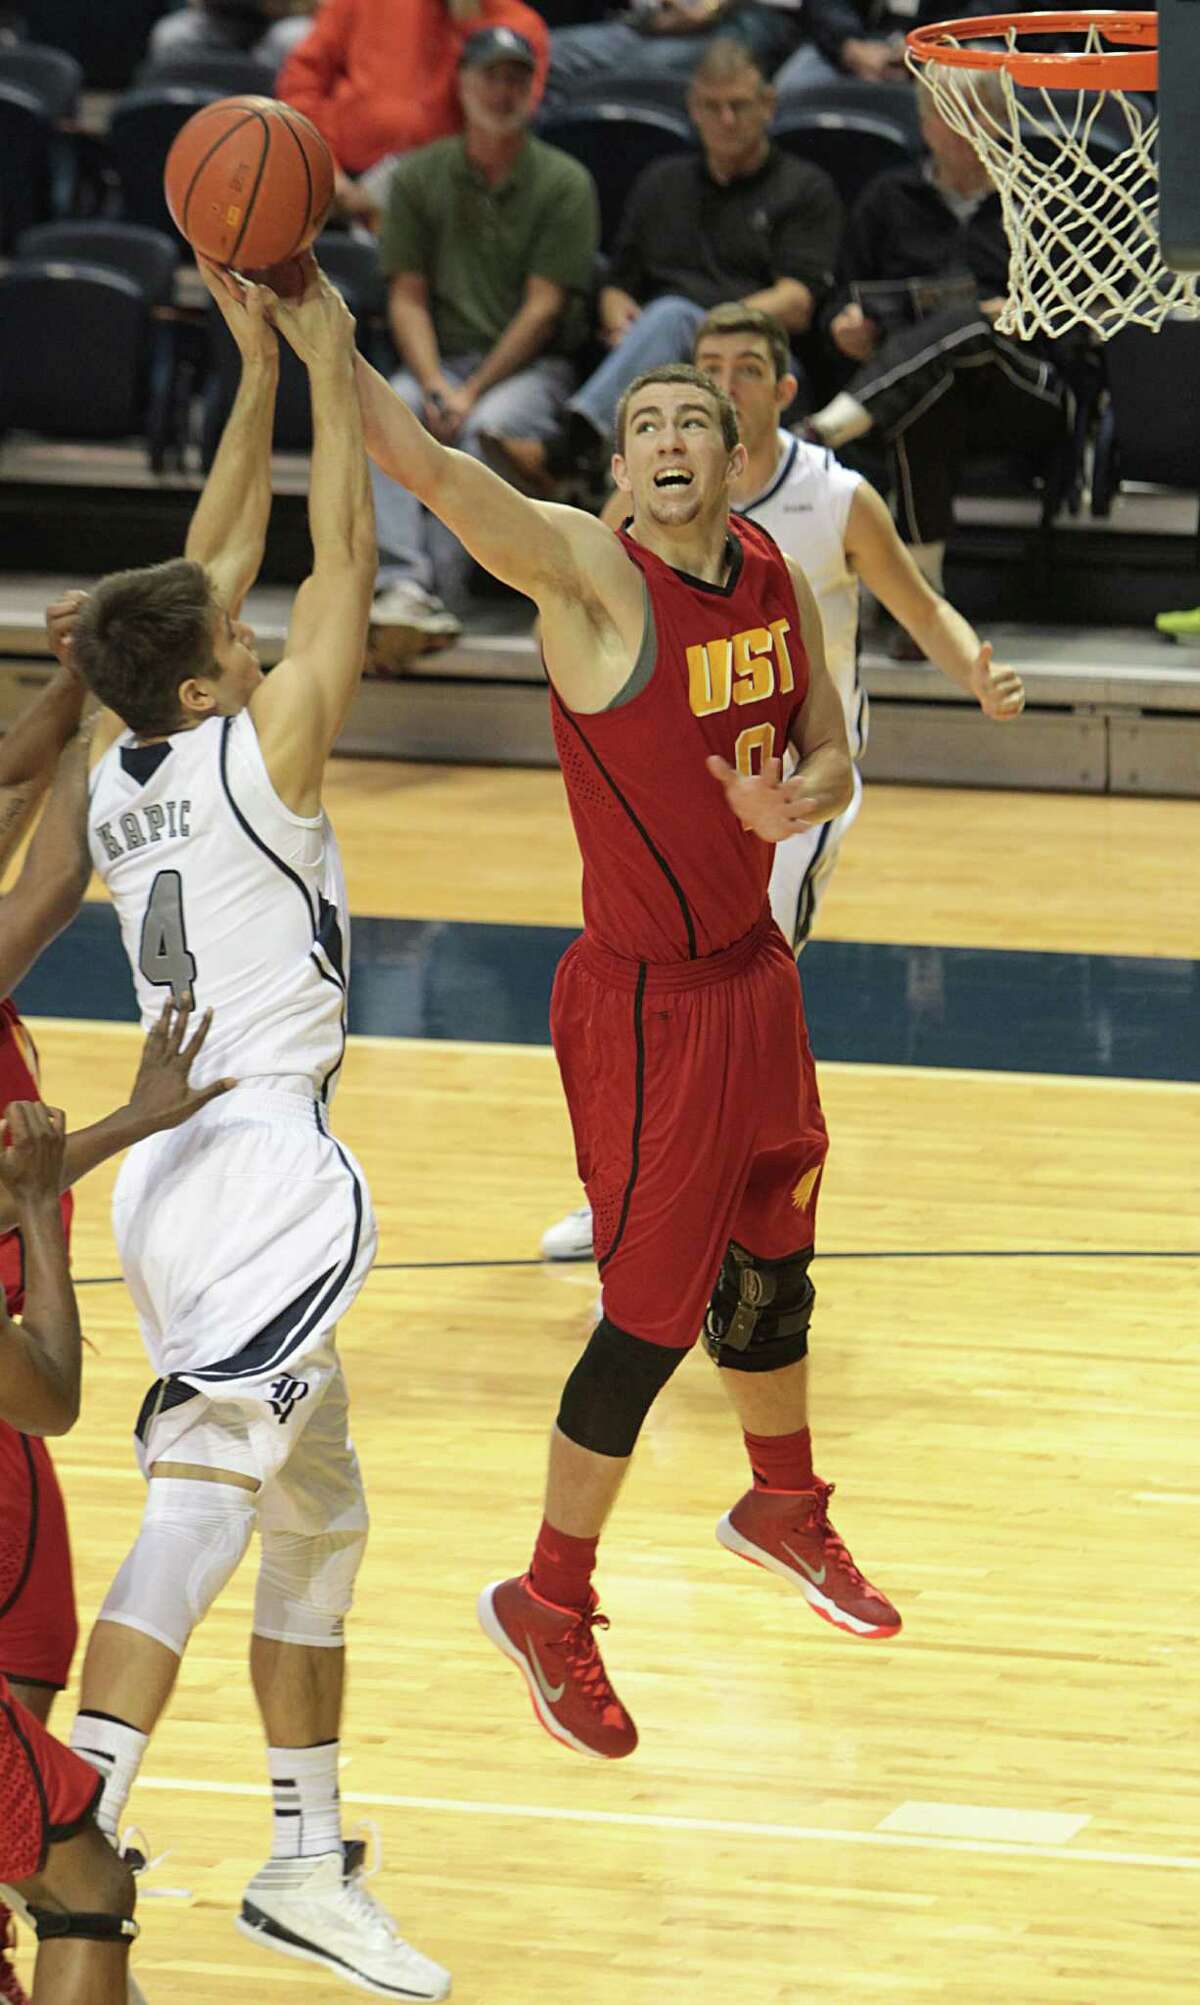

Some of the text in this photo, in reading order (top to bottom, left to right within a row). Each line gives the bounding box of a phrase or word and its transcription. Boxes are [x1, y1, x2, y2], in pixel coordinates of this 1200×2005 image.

[686, 618, 794, 717] UST
[96, 800, 191, 861] KAPIC
[139, 869, 197, 1012] 4
